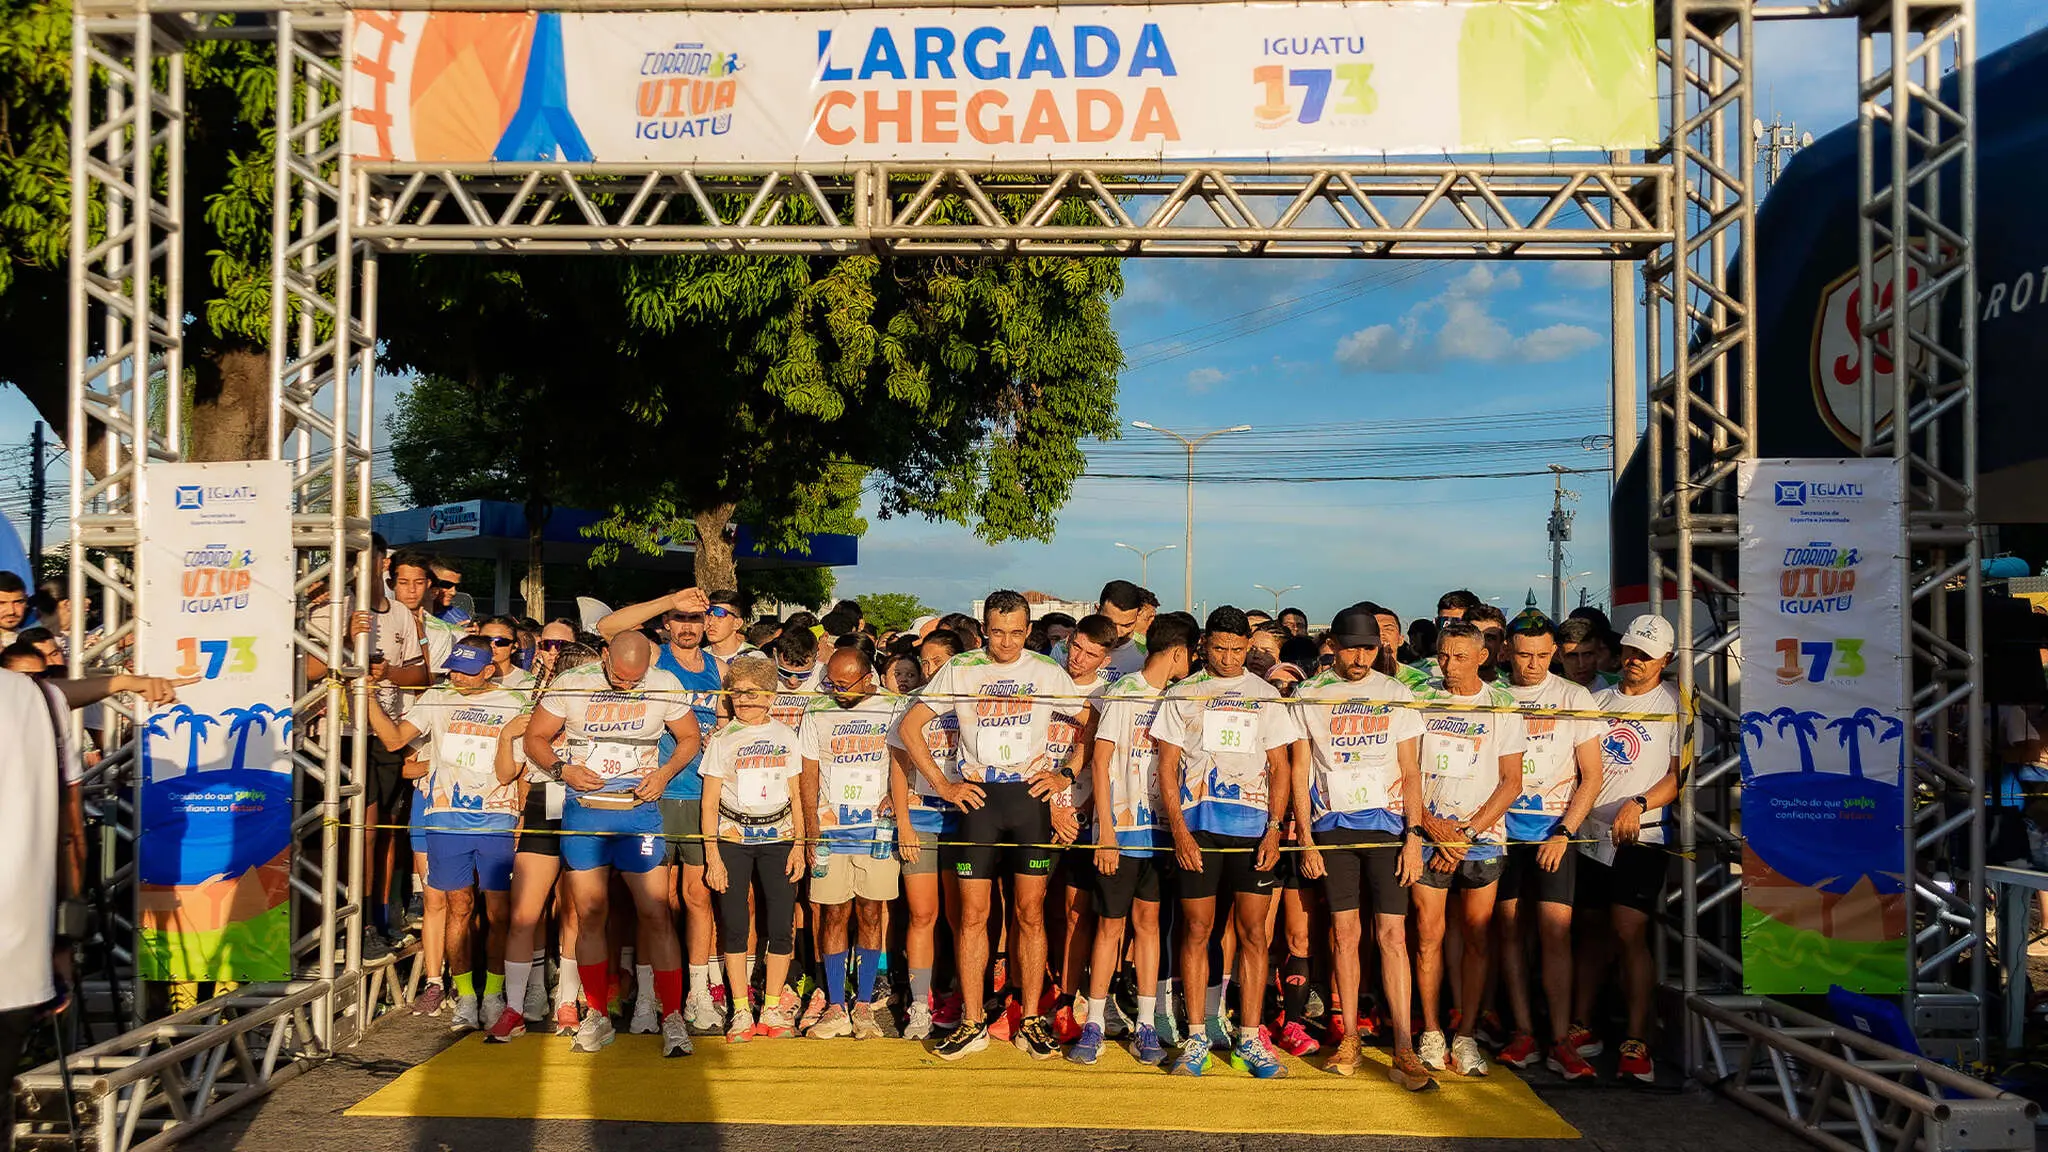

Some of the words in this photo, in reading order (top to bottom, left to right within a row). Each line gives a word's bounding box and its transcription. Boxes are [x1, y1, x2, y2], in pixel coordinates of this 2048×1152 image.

[818, 23, 1178, 81] LARGADA
[1264, 36, 1365, 56] IGUATU
[641, 52, 712, 76] CORRIDA
[636, 78, 736, 117] VIVA
[1253, 63, 1378, 124] 173
[814, 87, 1181, 145] CHEGADA
[636, 113, 732, 139] IGUATU
[1810, 482, 1863, 496] IGUATU
[184, 551, 232, 567] CORRIDA
[1783, 548, 1837, 567] CORRIDA
[182, 568, 251, 597] VIVA
[1780, 567, 1856, 598] VIVA
[181, 593, 249, 613] IGUATU
[1780, 594, 1852, 614] IGUATU
[176, 636, 258, 680] 173
[1775, 638, 1866, 683] 173
[584, 719, 645, 733] IGUATU
[978, 713, 1032, 727] IGUATU
[1330, 715, 1390, 735] VIVA
[1426, 718, 1469, 735] CORRIDA
[832, 723, 872, 736] CORRIDA
[1221, 729, 1241, 747] 383
[1331, 732, 1388, 747] IGUATU
[737, 744, 774, 757] CORRIDA
[834, 750, 882, 764] IGUATU
[999, 744, 1011, 761] 10
[601, 759, 622, 775] 389
[1436, 753, 1449, 770] 13
[205, 792, 216, 800] do
[217, 793, 233, 802] que
[761, 785, 767, 801] 4
[843, 784, 863, 800] 887
[1770, 798, 1808, 809] Orgulho
[1809, 798, 1821, 807] do
[1824, 799, 1841, 809] que
[1775, 810, 1822, 820] confiança
[1823, 812, 1837, 820] no
